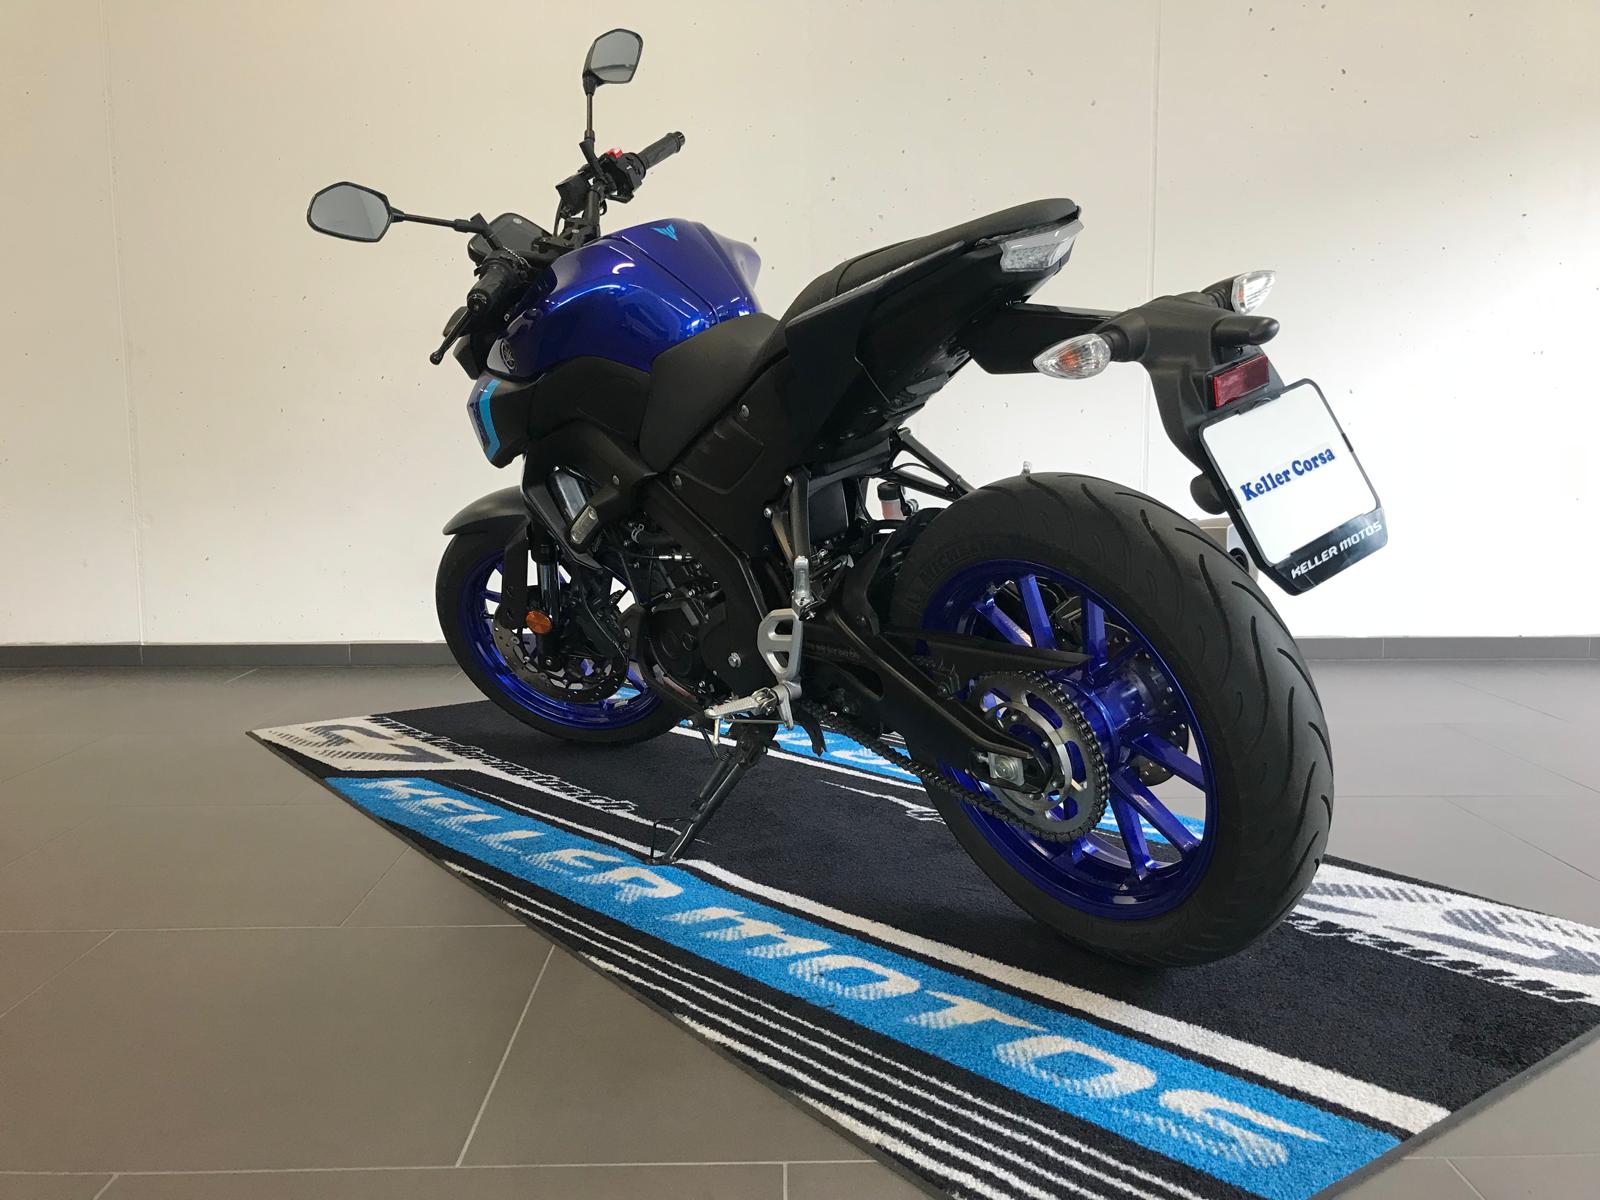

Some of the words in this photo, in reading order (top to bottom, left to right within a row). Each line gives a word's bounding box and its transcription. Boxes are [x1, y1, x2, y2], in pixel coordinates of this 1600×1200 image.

[1240, 469, 1291, 501] Keller
[1291, 447, 1335, 477] Corsa
[1291, 547, 1338, 579] KELLER
[350, 780, 683, 904] KELLER
